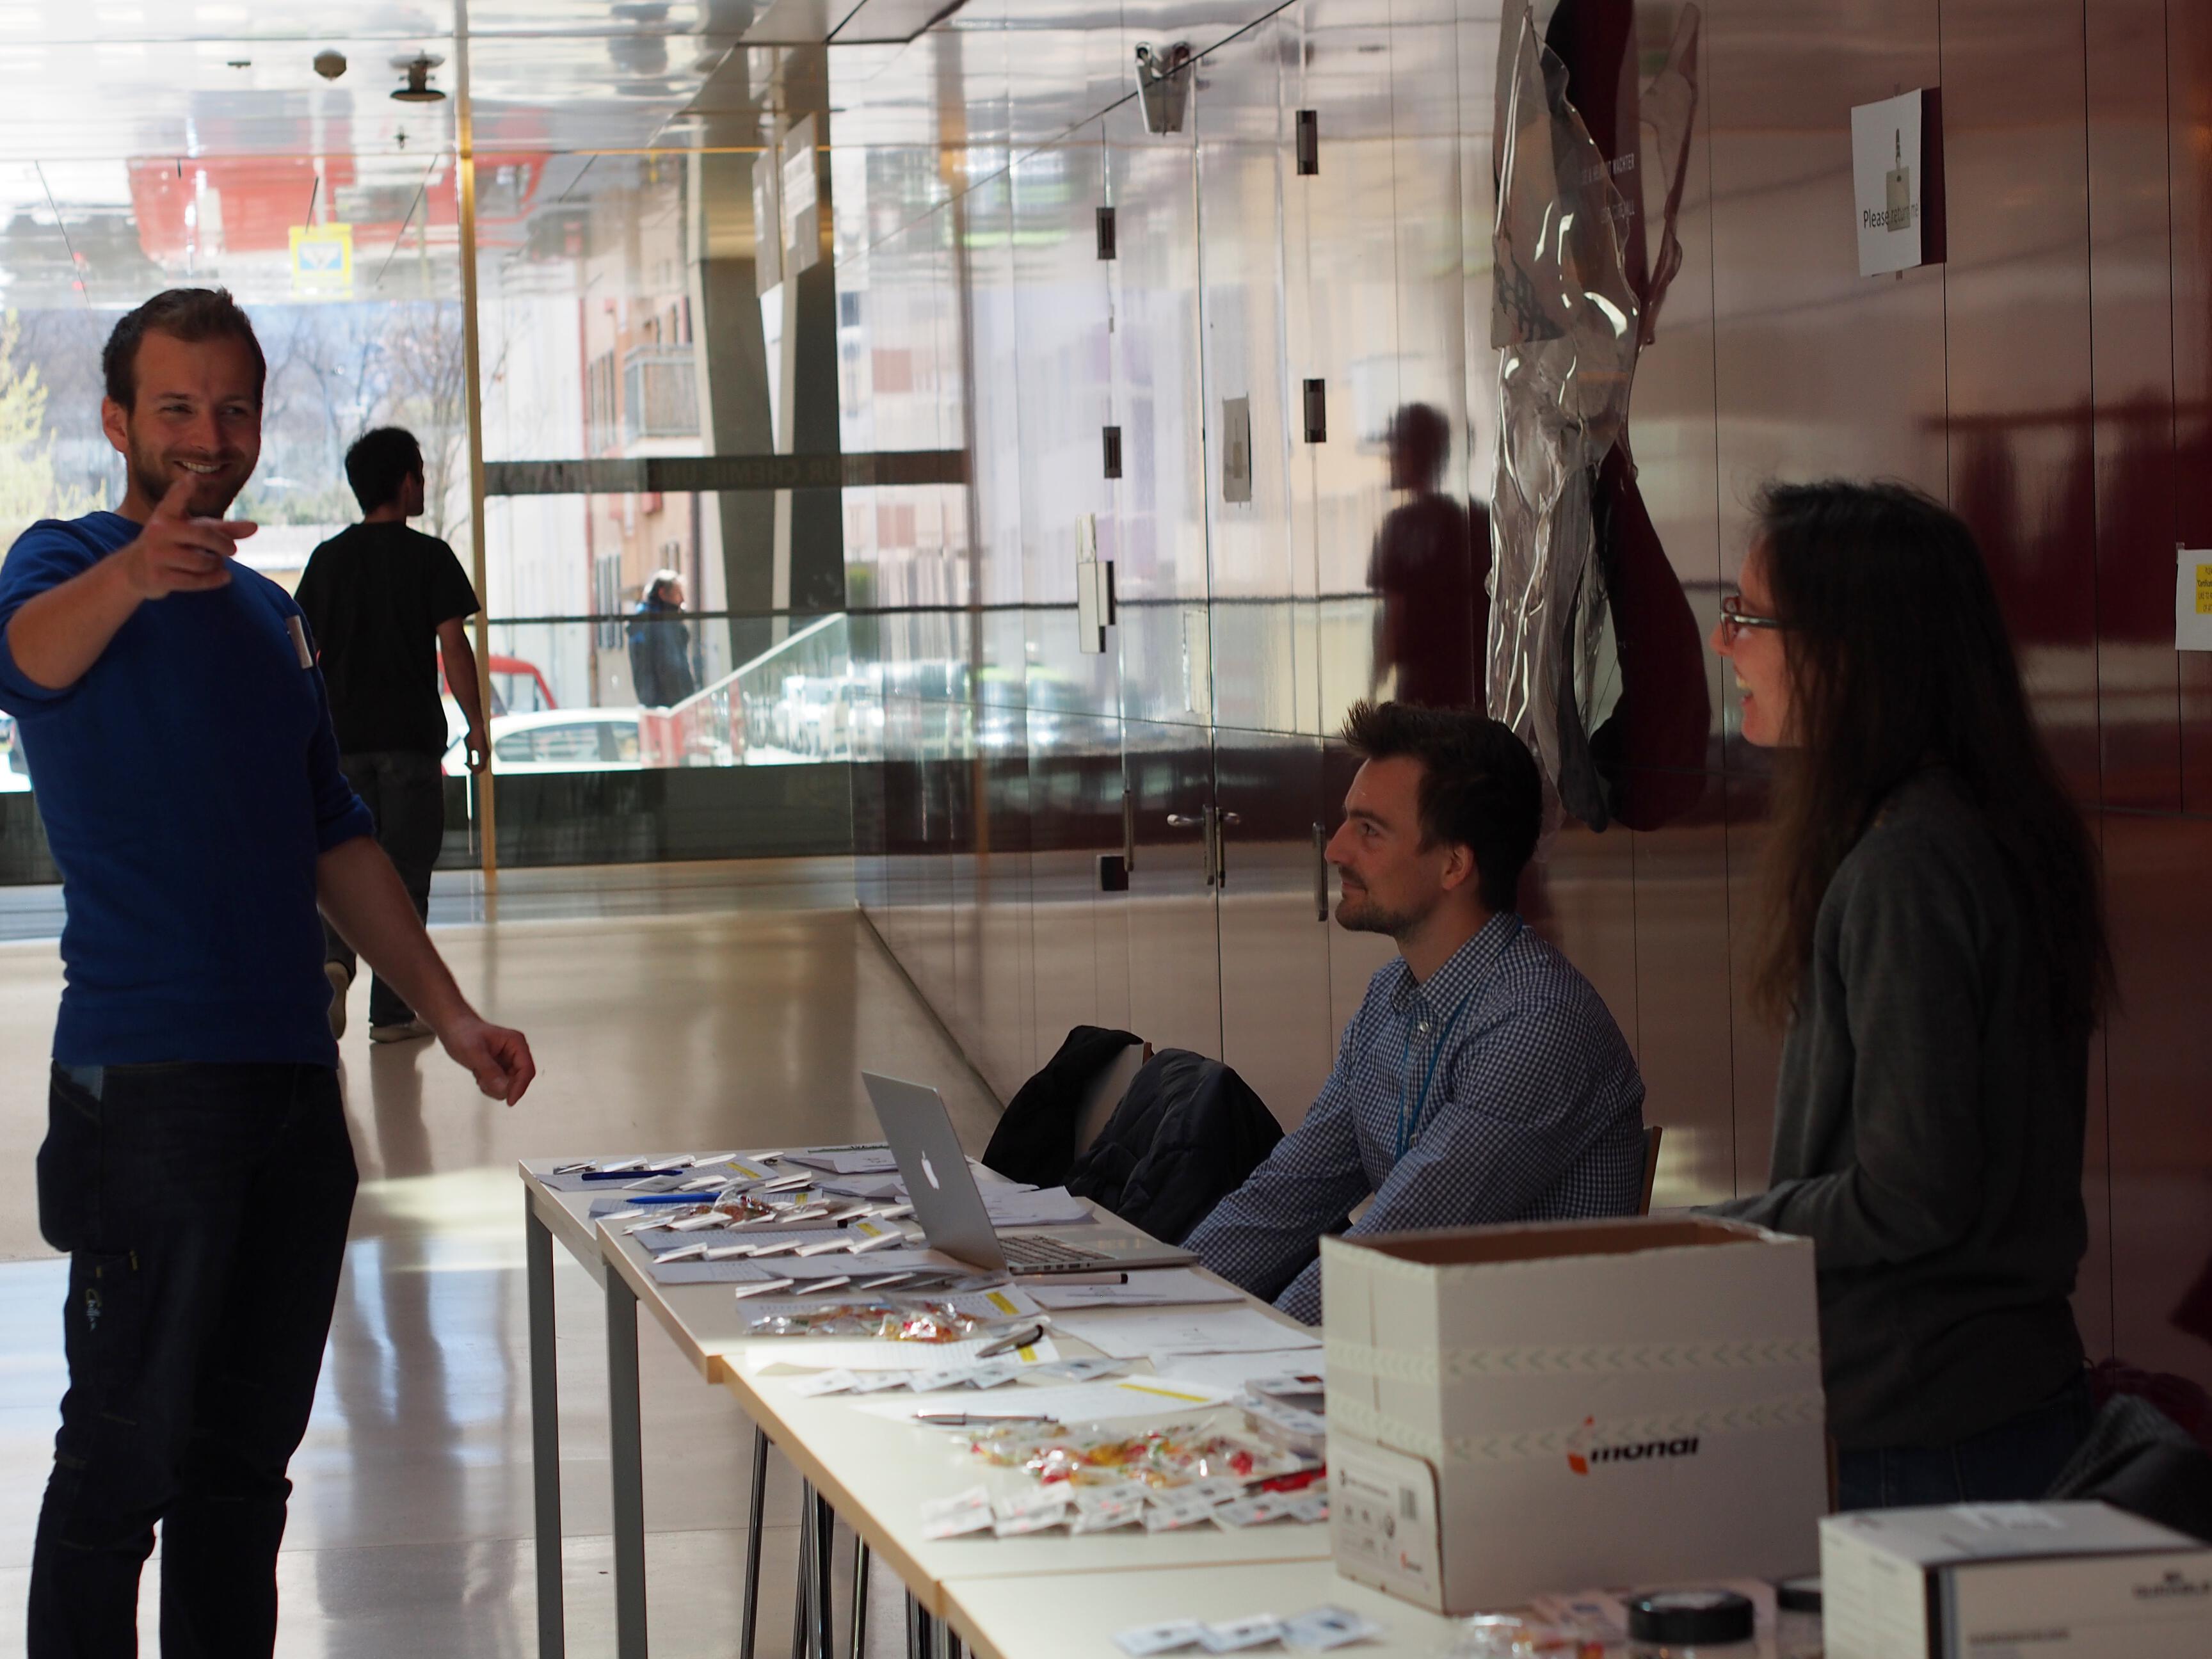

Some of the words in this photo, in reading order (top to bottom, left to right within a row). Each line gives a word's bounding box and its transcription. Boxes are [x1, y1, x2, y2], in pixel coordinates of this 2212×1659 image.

[1863, 208, 1889, 228] Please
[1890, 204, 1910, 223] return
[1590, 1436, 1700, 1464] mondi
